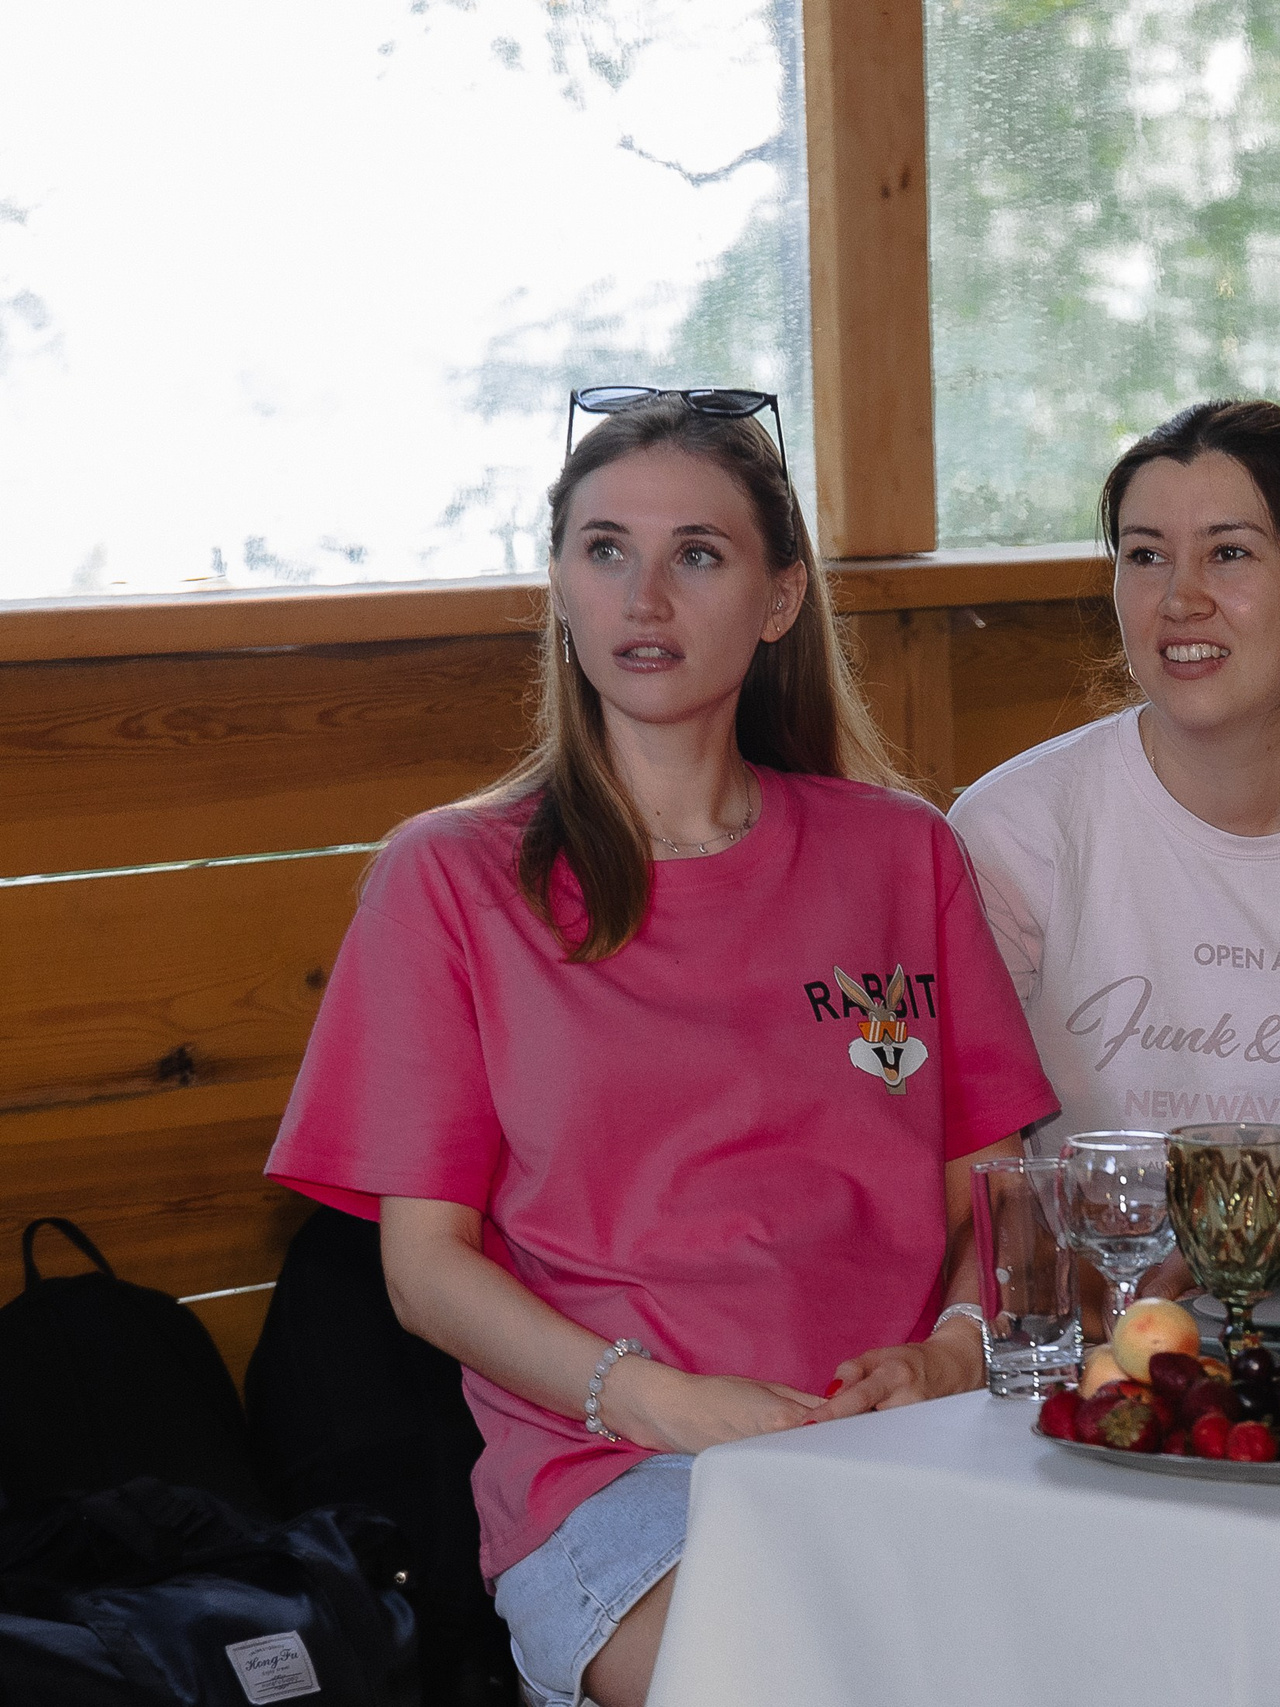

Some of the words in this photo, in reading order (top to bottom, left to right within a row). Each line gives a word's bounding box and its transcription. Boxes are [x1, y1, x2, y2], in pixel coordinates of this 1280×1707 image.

[1194, 942, 1265, 970] OPEN
[1065, 975, 1241, 1072] Funk
[1124, 1089, 1201, 1120] NEW
